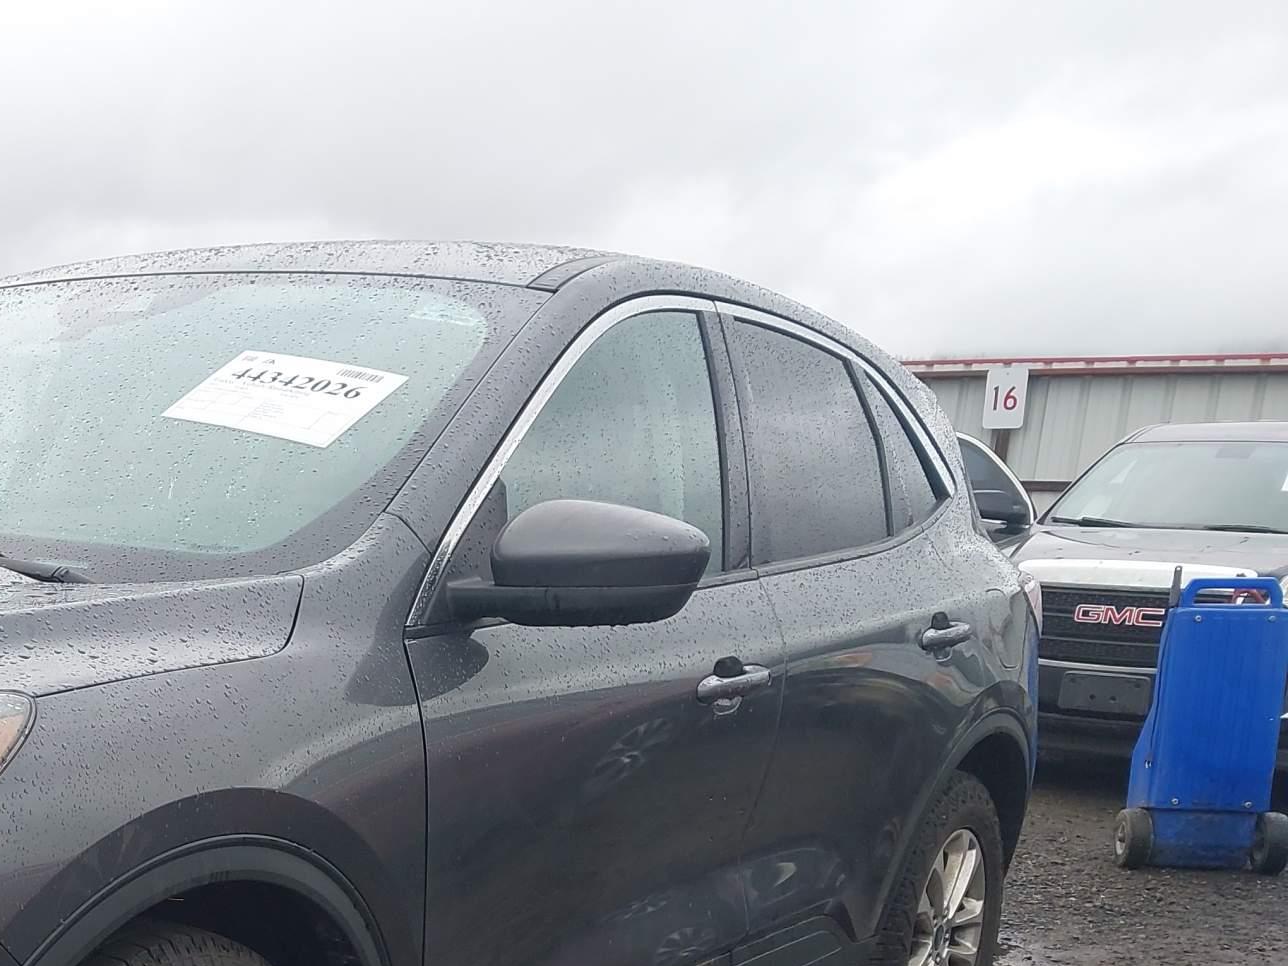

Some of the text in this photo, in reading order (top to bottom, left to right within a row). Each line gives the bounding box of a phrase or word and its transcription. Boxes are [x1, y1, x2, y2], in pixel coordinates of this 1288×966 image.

[231, 367, 368, 400] 44342026
[992, 385, 1017, 411] 16
[1074, 603, 1166, 627] GMC
